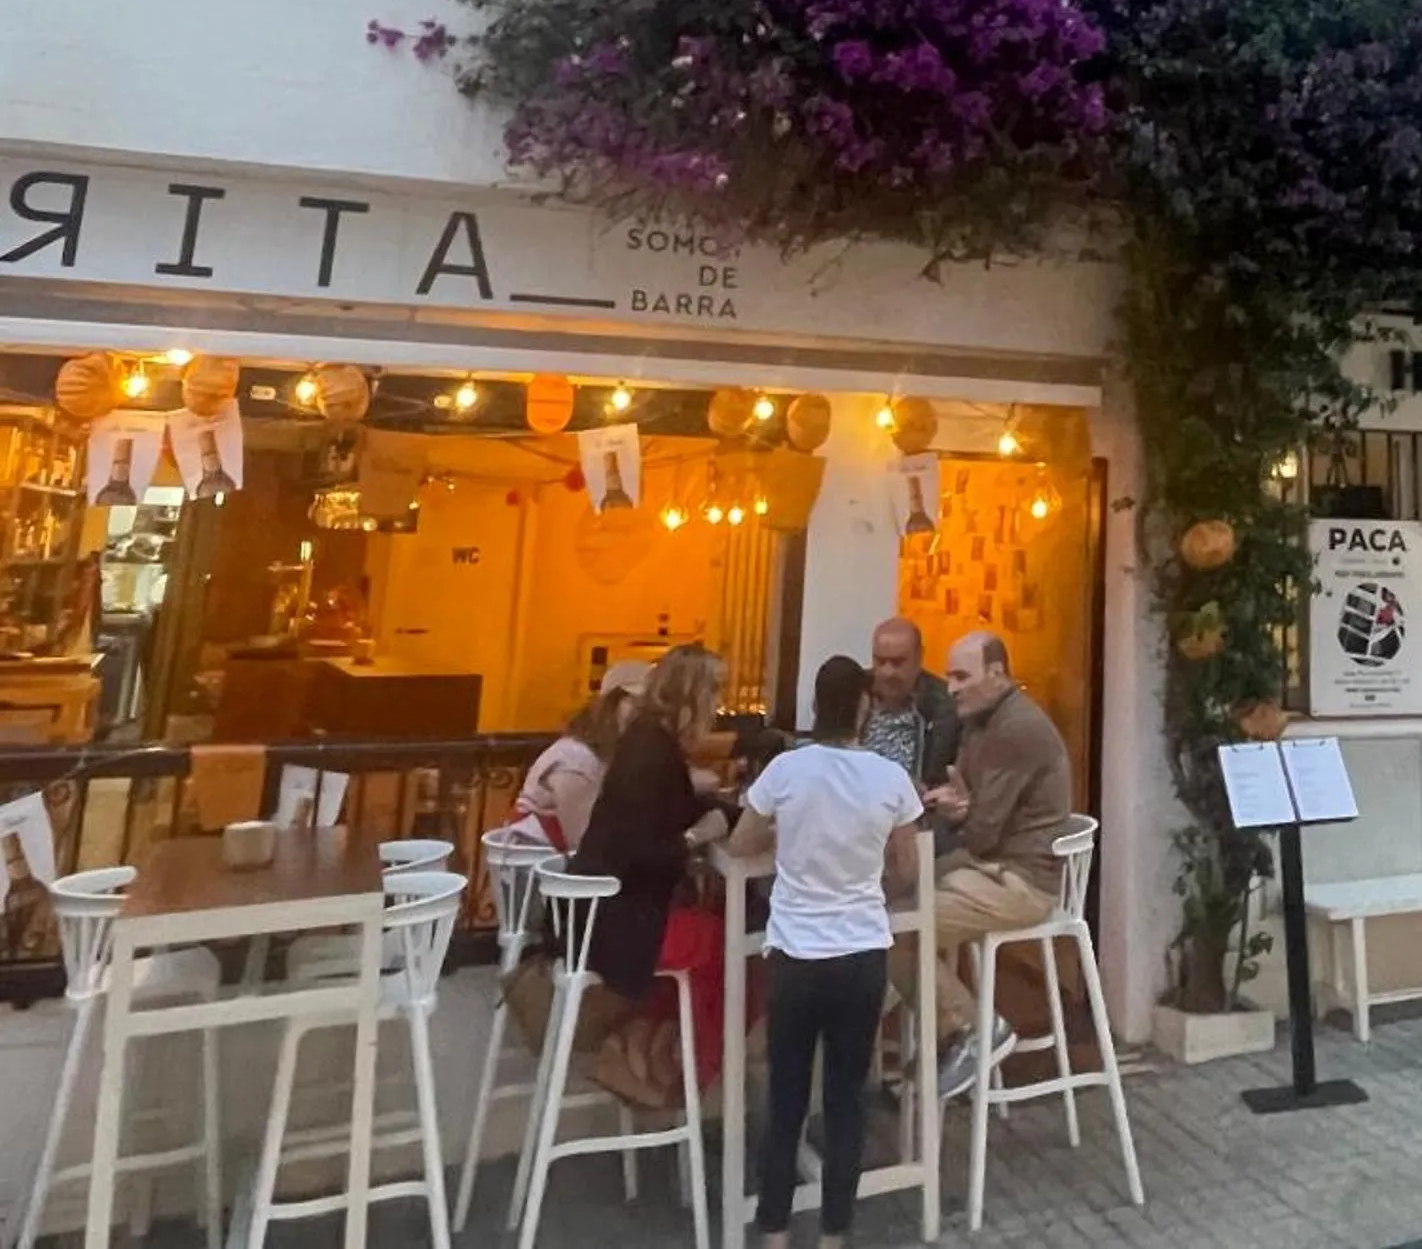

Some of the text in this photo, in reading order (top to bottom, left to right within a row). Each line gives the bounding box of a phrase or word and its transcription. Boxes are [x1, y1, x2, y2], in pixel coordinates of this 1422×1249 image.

[627, 228, 740, 257] SOMO
[699, 265, 738, 288] DE
[632, 290, 737, 318] BARRA
[1329, 528, 1406, 551] PACA
